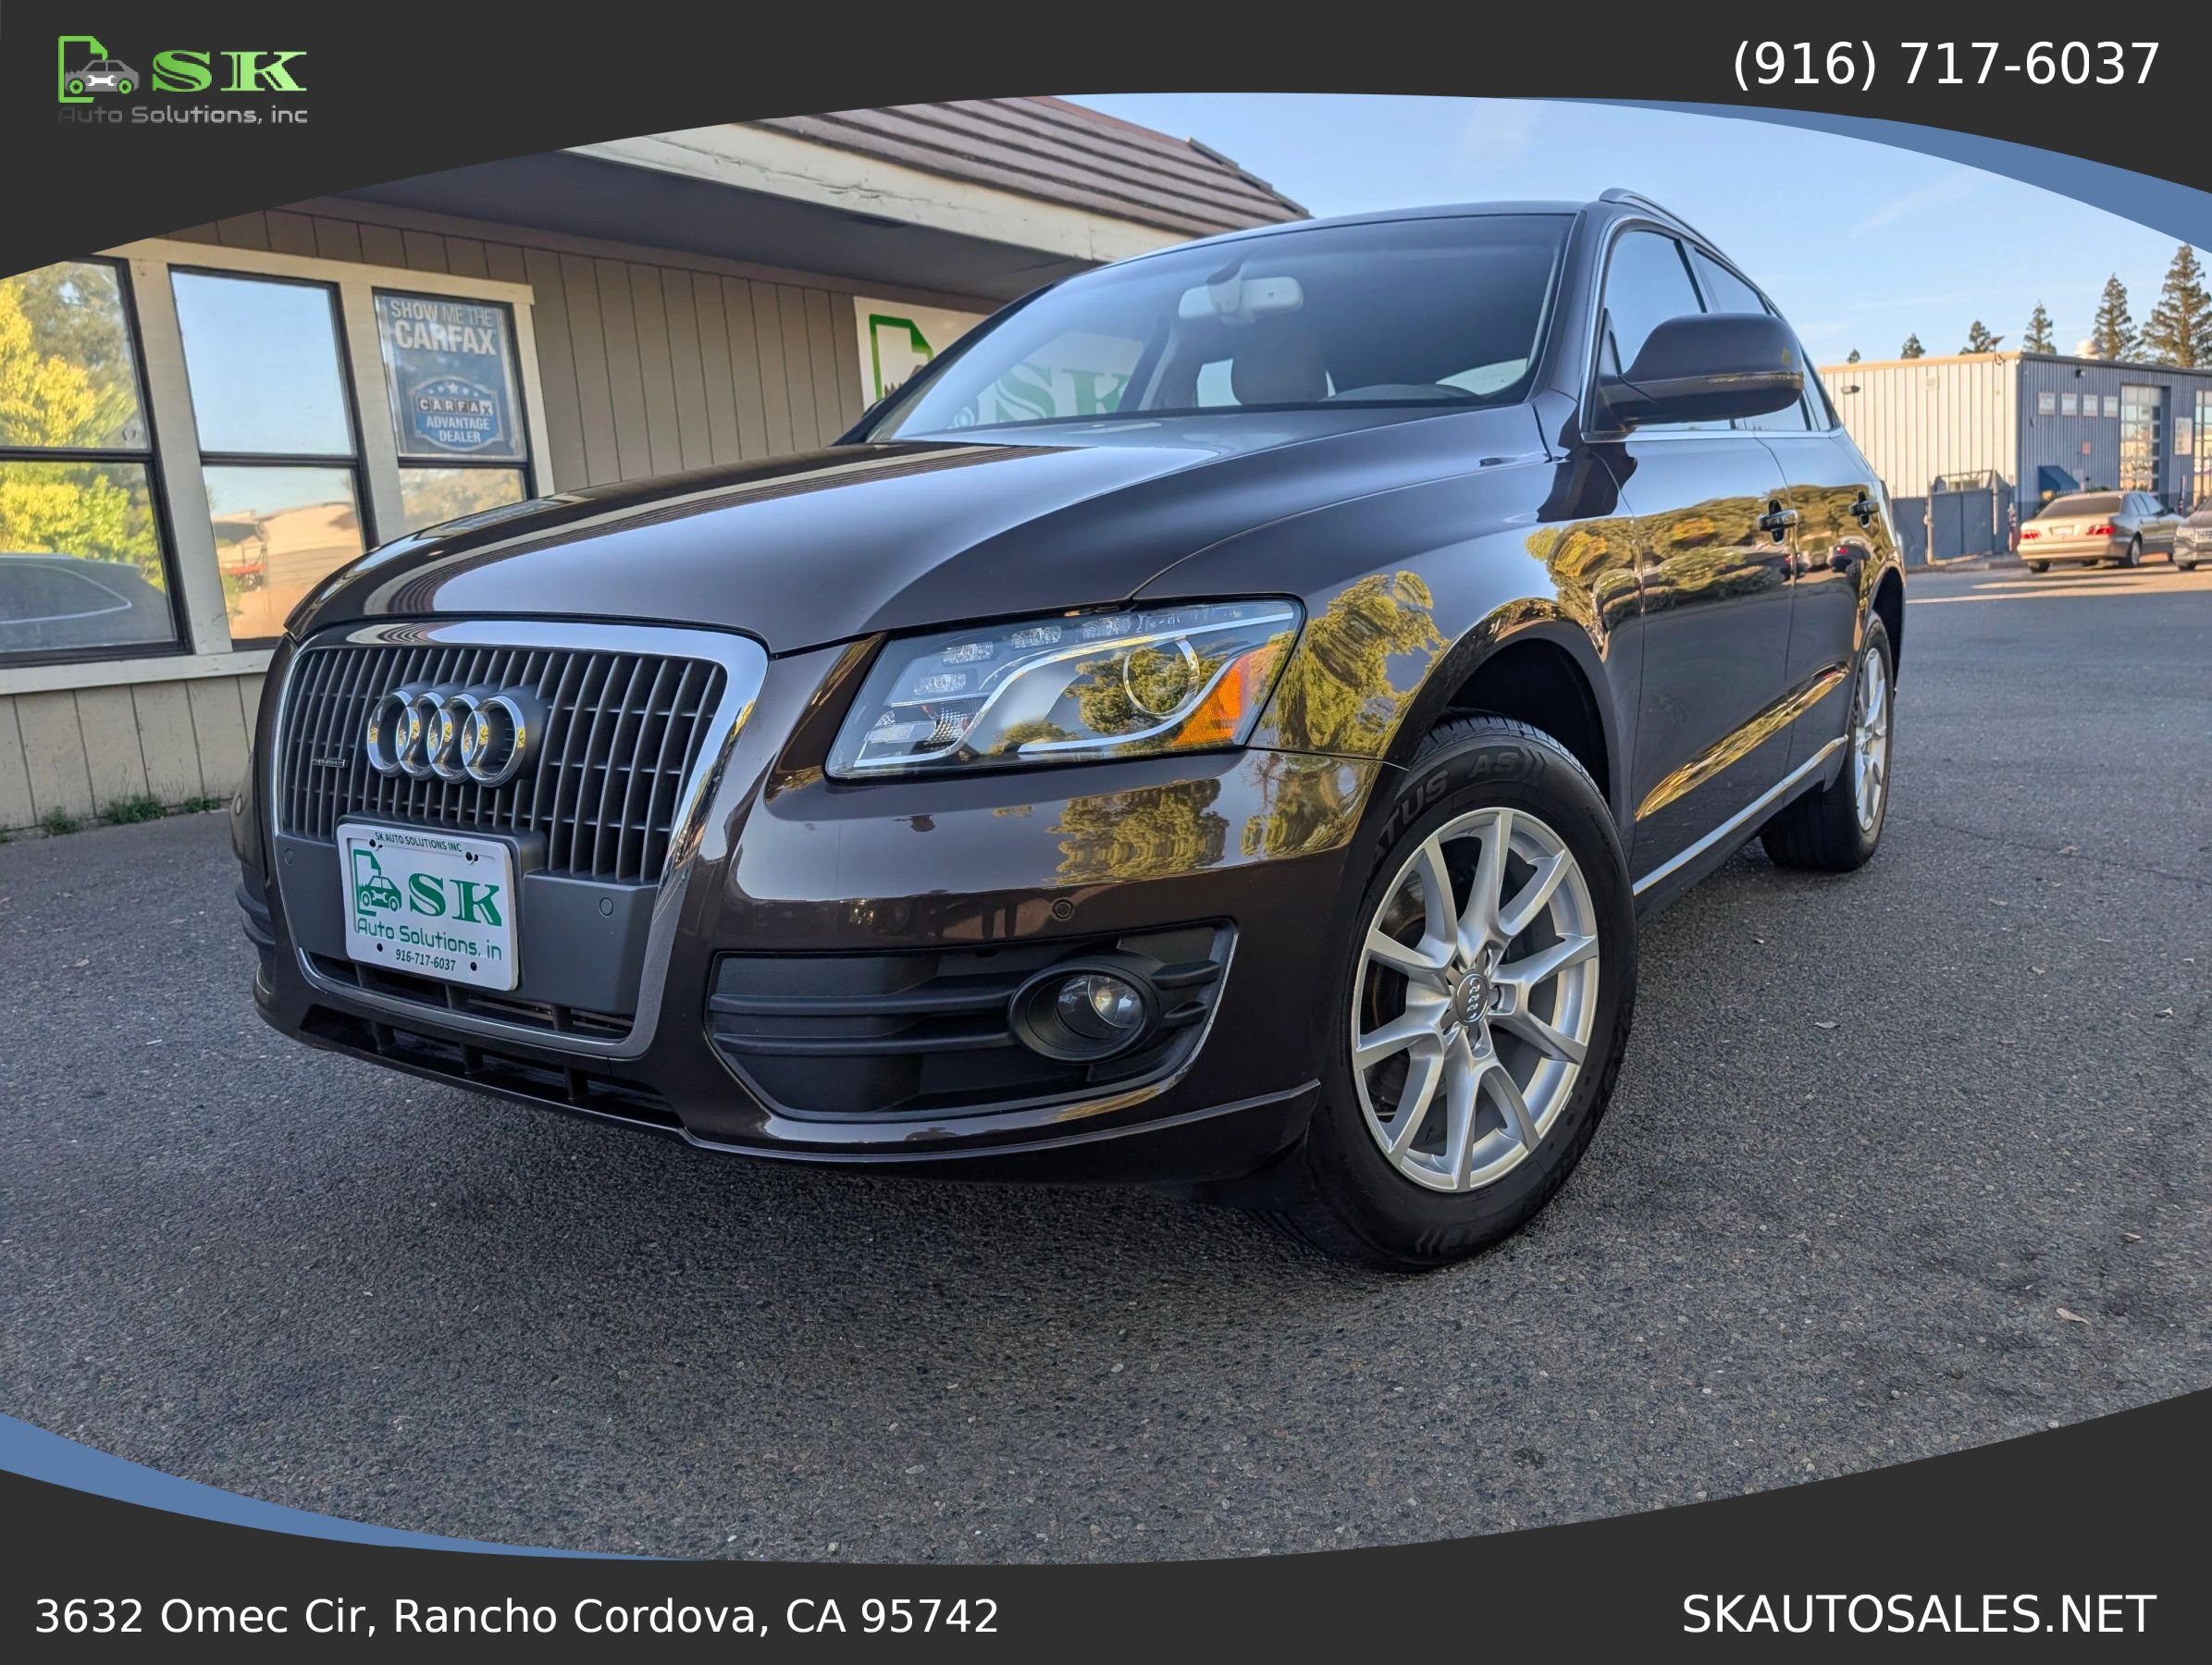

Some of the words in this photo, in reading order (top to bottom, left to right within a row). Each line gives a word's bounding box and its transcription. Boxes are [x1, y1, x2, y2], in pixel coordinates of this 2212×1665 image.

[390, 300, 439, 322] SHOW
[442, 306, 464, 325] ME
[467, 309, 493, 327] THE
[394, 319, 497, 356] CARFAX
[419, 399, 491, 414] CARFAX
[426, 415, 490, 430] ADVANTAGE
[439, 430, 481, 443] DEALER
[375, 832, 385, 842] SK
[385, 833, 404, 845] AUTO
[406, 836, 448, 850] SOLUTIONS
[448, 843, 463, 852] INC
[408, 872, 502, 927] SK
[357, 918, 395, 940] Auto
[395, 948, 456, 971] 916-717-6037
